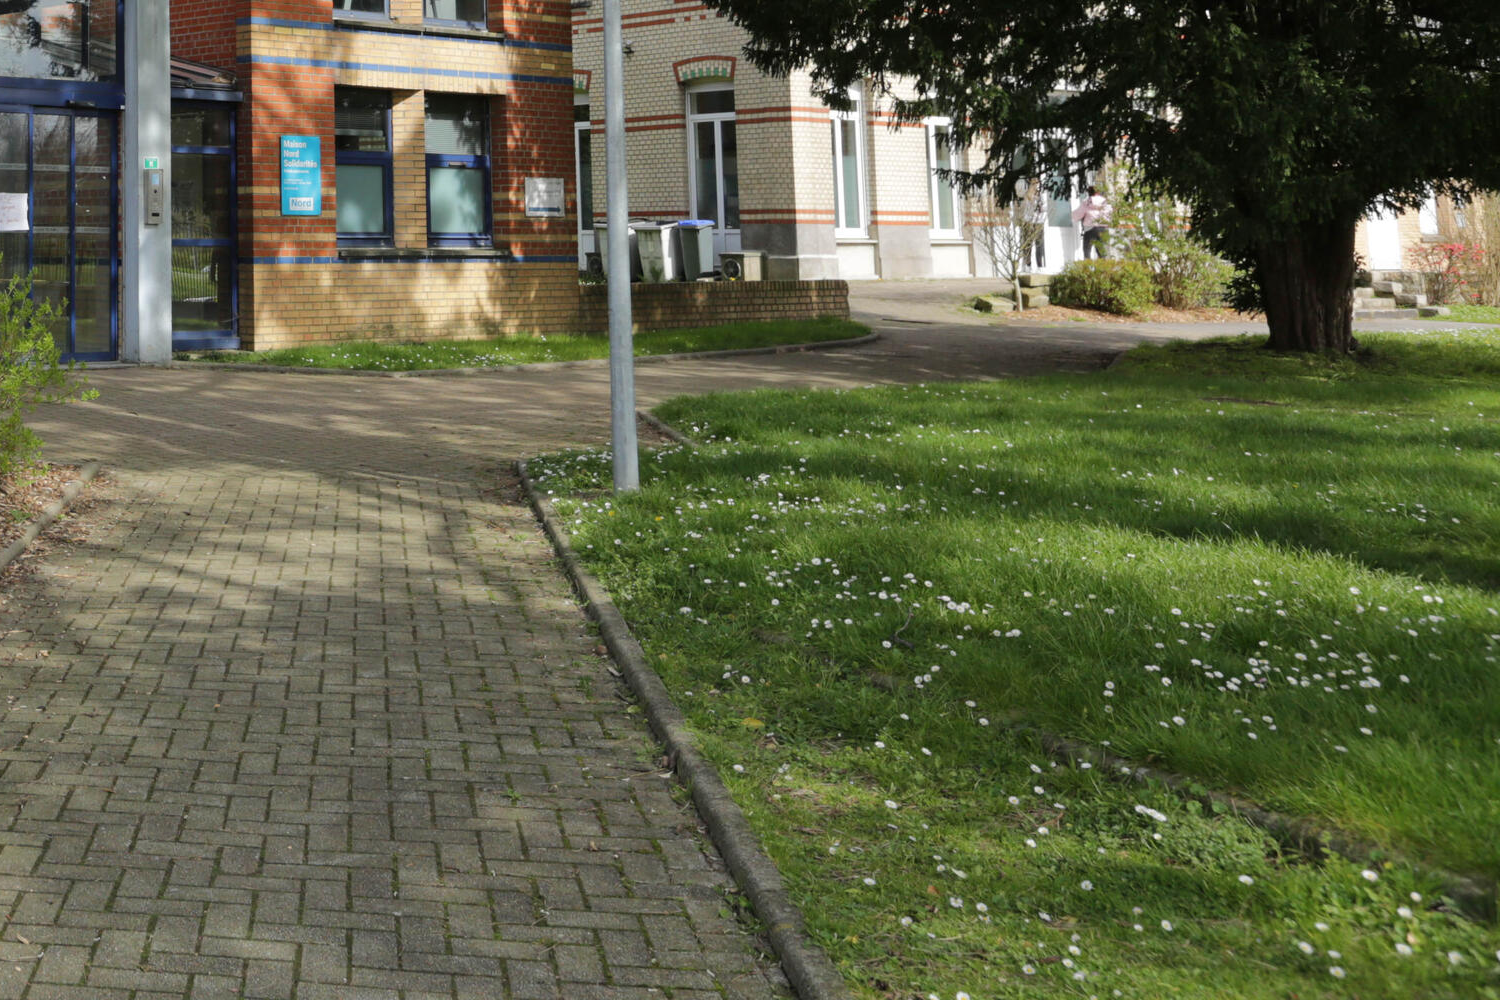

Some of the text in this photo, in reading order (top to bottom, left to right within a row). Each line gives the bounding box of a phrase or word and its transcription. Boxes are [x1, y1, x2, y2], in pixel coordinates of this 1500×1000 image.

[283, 140, 307, 149] Maison
[283, 149, 300, 158] Nord
[291, 198, 312, 207] Nord
